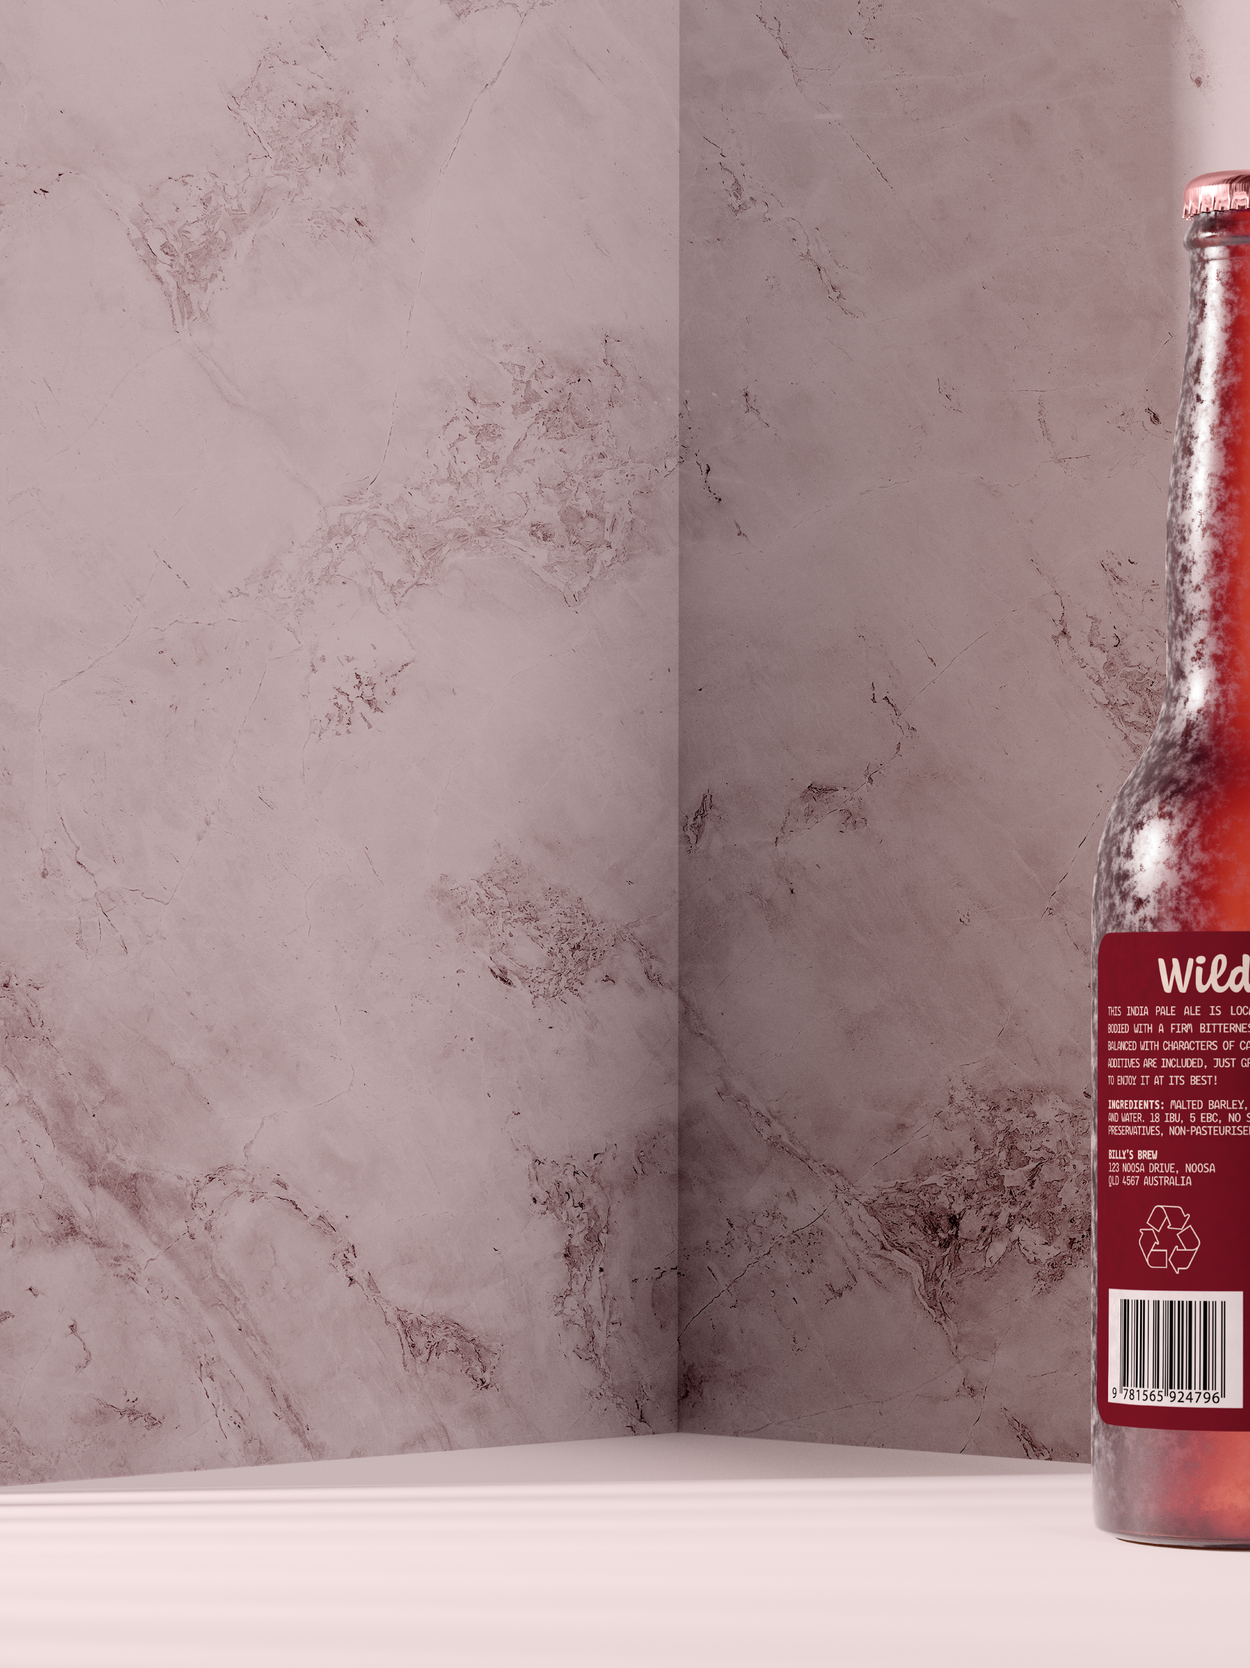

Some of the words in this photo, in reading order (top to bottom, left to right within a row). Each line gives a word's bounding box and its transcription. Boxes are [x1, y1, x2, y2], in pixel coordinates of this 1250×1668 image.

[1107, 1005, 1122, 1017] THIS
[1126, 1005, 1149, 1017] INDIA
[1155, 1005, 1177, 1016] PALE
[1183, 1005, 1202, 1016] ALE
[1209, 1005, 1222, 1016] IS
[1107, 1023, 1130, 1034] BODIED
[1133, 1023, 1153, 1034] WITH
[1158, 1023, 1165, 1034] A
[1170, 1022, 1194, 1034] FIRM
[1107, 1040, 1138, 1051] BALANCED
[1139, 1040, 1160, 1051] WITH
[1162, 1040, 1219, 1051] CHARACTERS
[1222, 1040, 1236, 1051] OF
[1107, 1057, 1141, 1069] ADDITIVES
[1142, 1057, 1158, 1069] ARE
[1160, 1057, 1208, 1070] INCLUDED,
[1213, 1057, 1237, 1069] JUST
[1107, 1074, 1115, 1086] TO
[1116, 1075, 1137, 1086] ENJOY
[1140, 1075, 1151, 1086] IT
[1153, 1075, 1165, 1086] AT
[1168, 1074, 1186, 1086] ITS
[1189, 1074, 1218, 1086] BEST!
[1107, 1099, 1165, 1110] INGREDIENTS:
[1169, 1099, 1204, 1110] MALTED
[1208, 1099, 1248, 1111] BARLEY,
[1107, 1112, 1120, 1123] AND
[1120, 1112, 1145, 1123] WATER.
[1149, 1112, 1161, 1123] 18
[1164, 1112, 1184, 1124] IBU,
[1189, 1112, 1196, 1123] 5
[1200, 1112, 1222, 1124] EBC,
[1228, 1112, 1242, 1123] NO
[1108, 1124, 1164, 1137] PRESERVATIVES,
[1137, 1149, 1158, 1160] BREW
[1108, 1162, 1120, 1173] 123
[1122, 1162, 1145, 1173] NOOSA
[1148, 1162, 1179, 1175] DRIVE,
[1185, 1162, 1216, 1174] NOOSA
[1108, 1174, 1120, 1188] QLD
[1121, 1175, 1140, 1186] 4567
[1143, 1175, 1193, 1187] AUSTRALIA
[1111, 1388, 1118, 1399] 9
[1123, 1389, 1164, 1402] 781565
[1169, 1391, 1220, 1404] 924796
